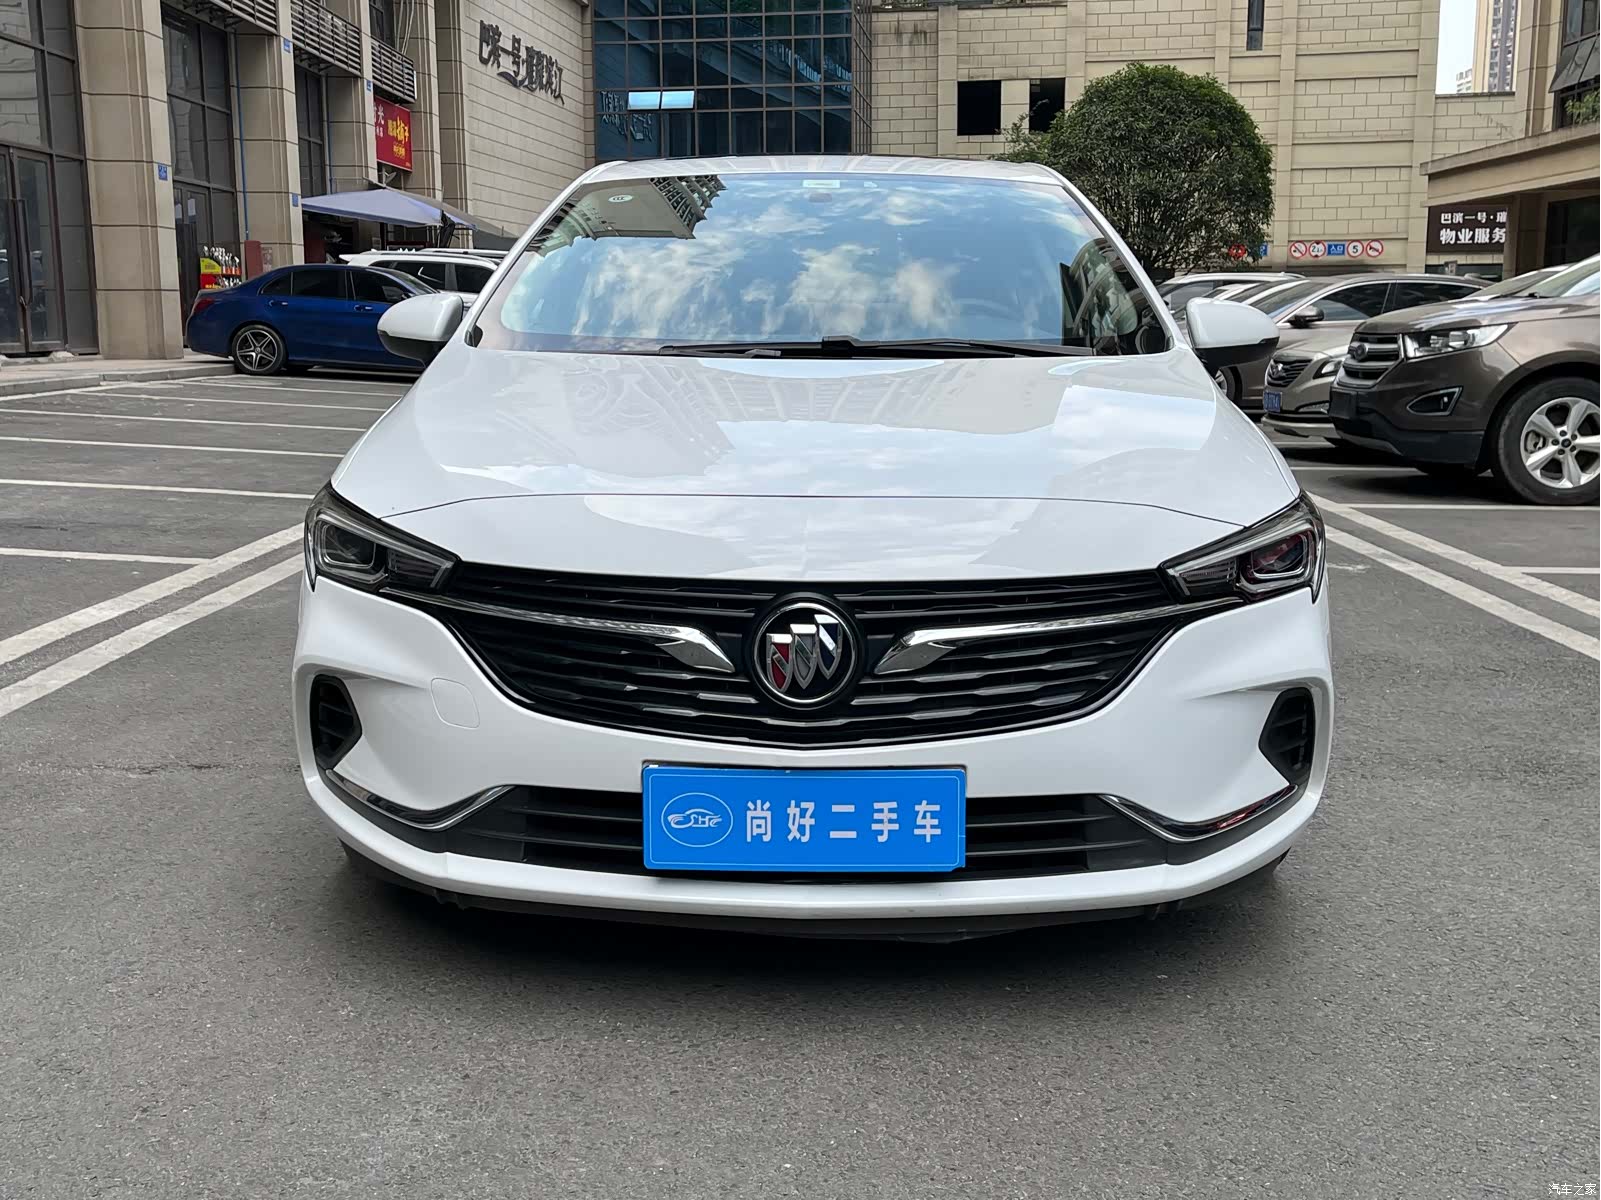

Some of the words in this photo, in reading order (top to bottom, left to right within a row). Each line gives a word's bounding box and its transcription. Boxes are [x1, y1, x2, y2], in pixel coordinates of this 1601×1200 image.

[1439, 227, 1507, 245] 物业服务
[1352, 245, 1359, 254] 5
[746, 799, 942, 843] 尚好二手车
